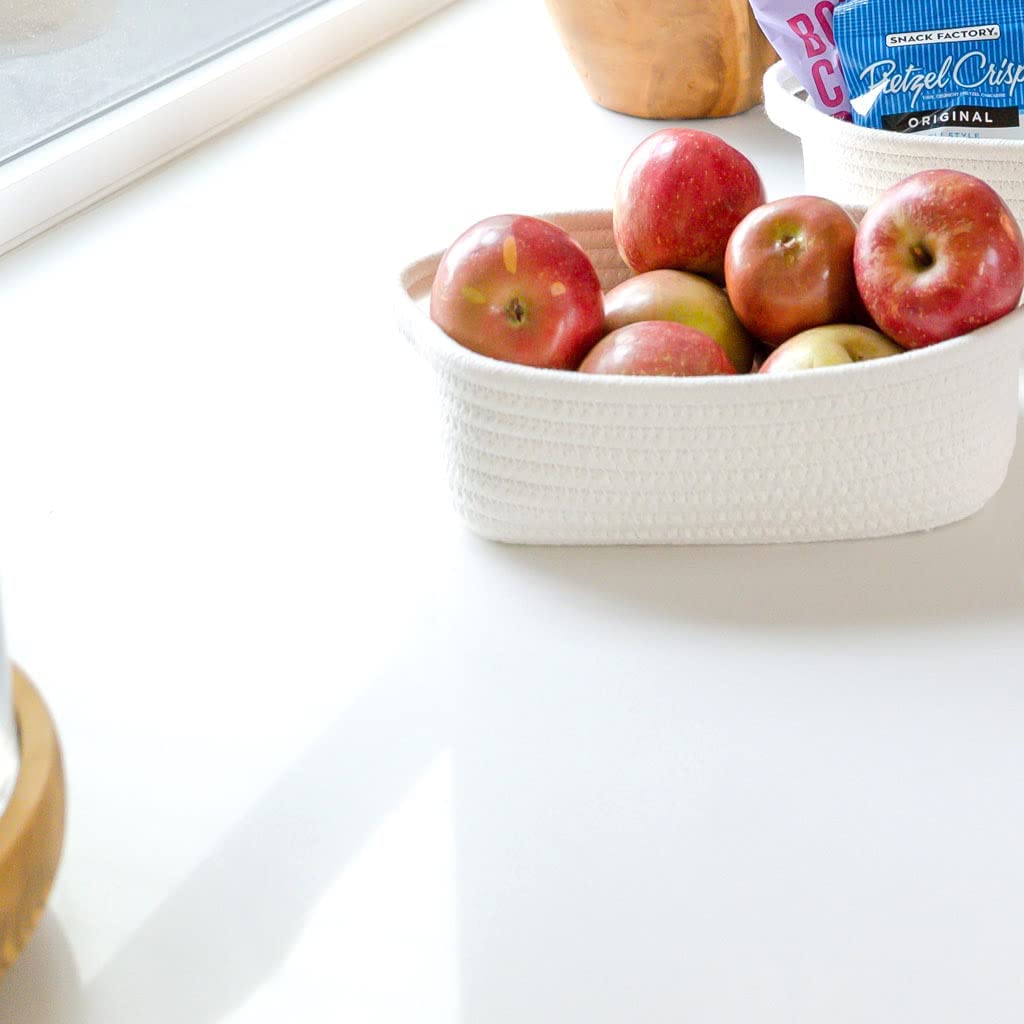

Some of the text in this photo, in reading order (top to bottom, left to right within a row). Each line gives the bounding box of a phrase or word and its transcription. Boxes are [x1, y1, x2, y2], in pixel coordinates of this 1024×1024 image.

[890, 28, 995, 44] SNACK FACTORY
[860, 55, 953, 108] Pretzel
[908, 110, 993, 127] ORIGINAL
